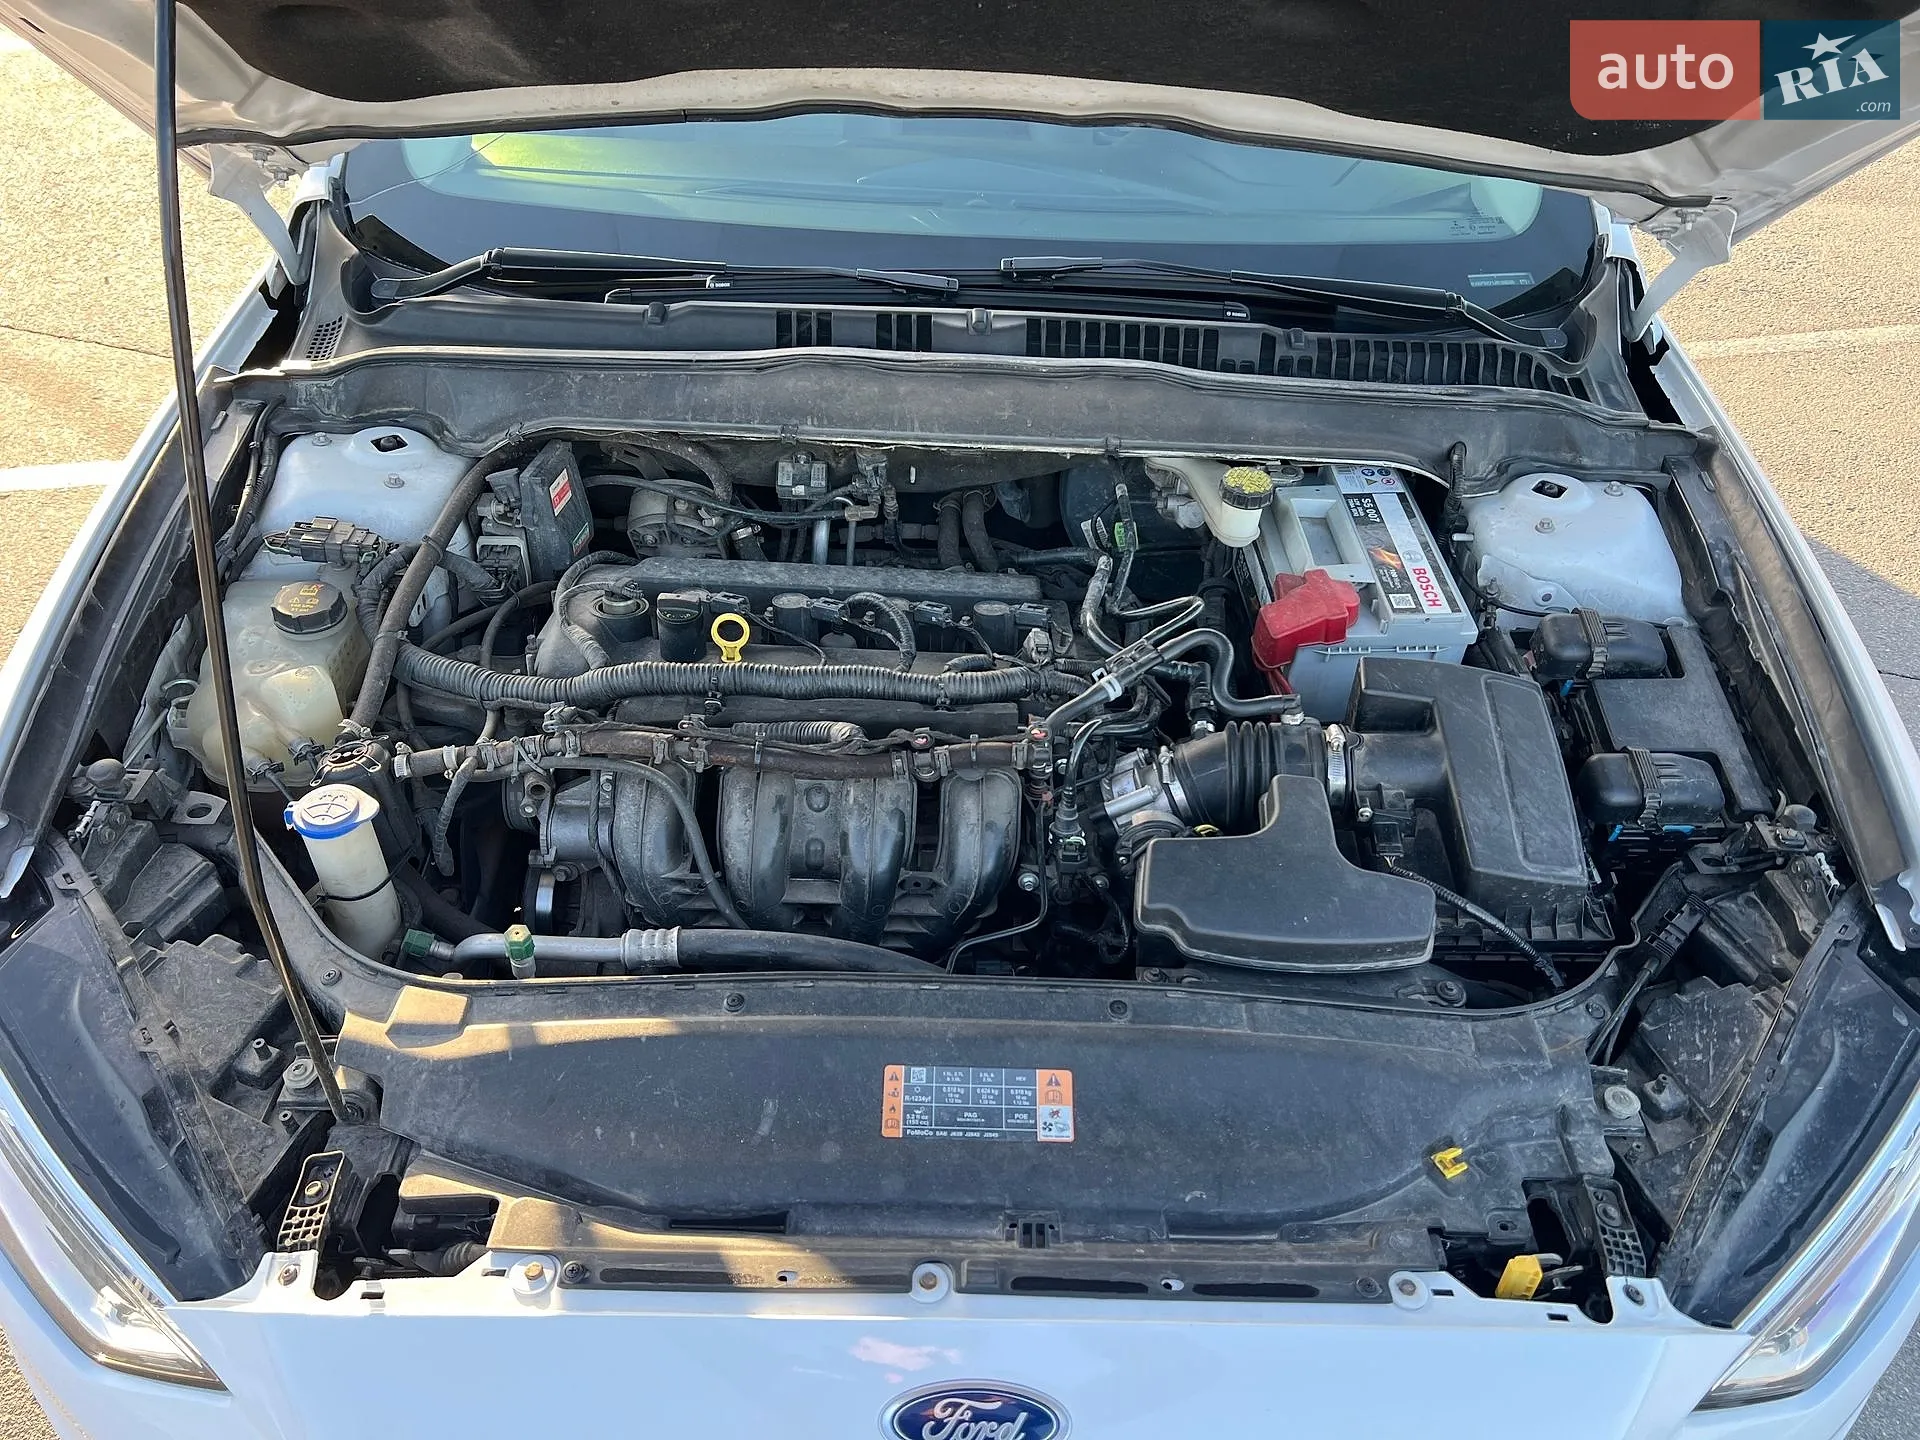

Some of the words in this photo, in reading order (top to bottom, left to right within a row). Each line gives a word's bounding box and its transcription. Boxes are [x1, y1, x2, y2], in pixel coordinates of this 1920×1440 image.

[1366, 508, 1381, 522] 007
[1412, 567, 1442, 609] BOSCH
[906, 1128, 934, 1136] FoMoCo
[922, 1397, 1028, 1440] Ford
